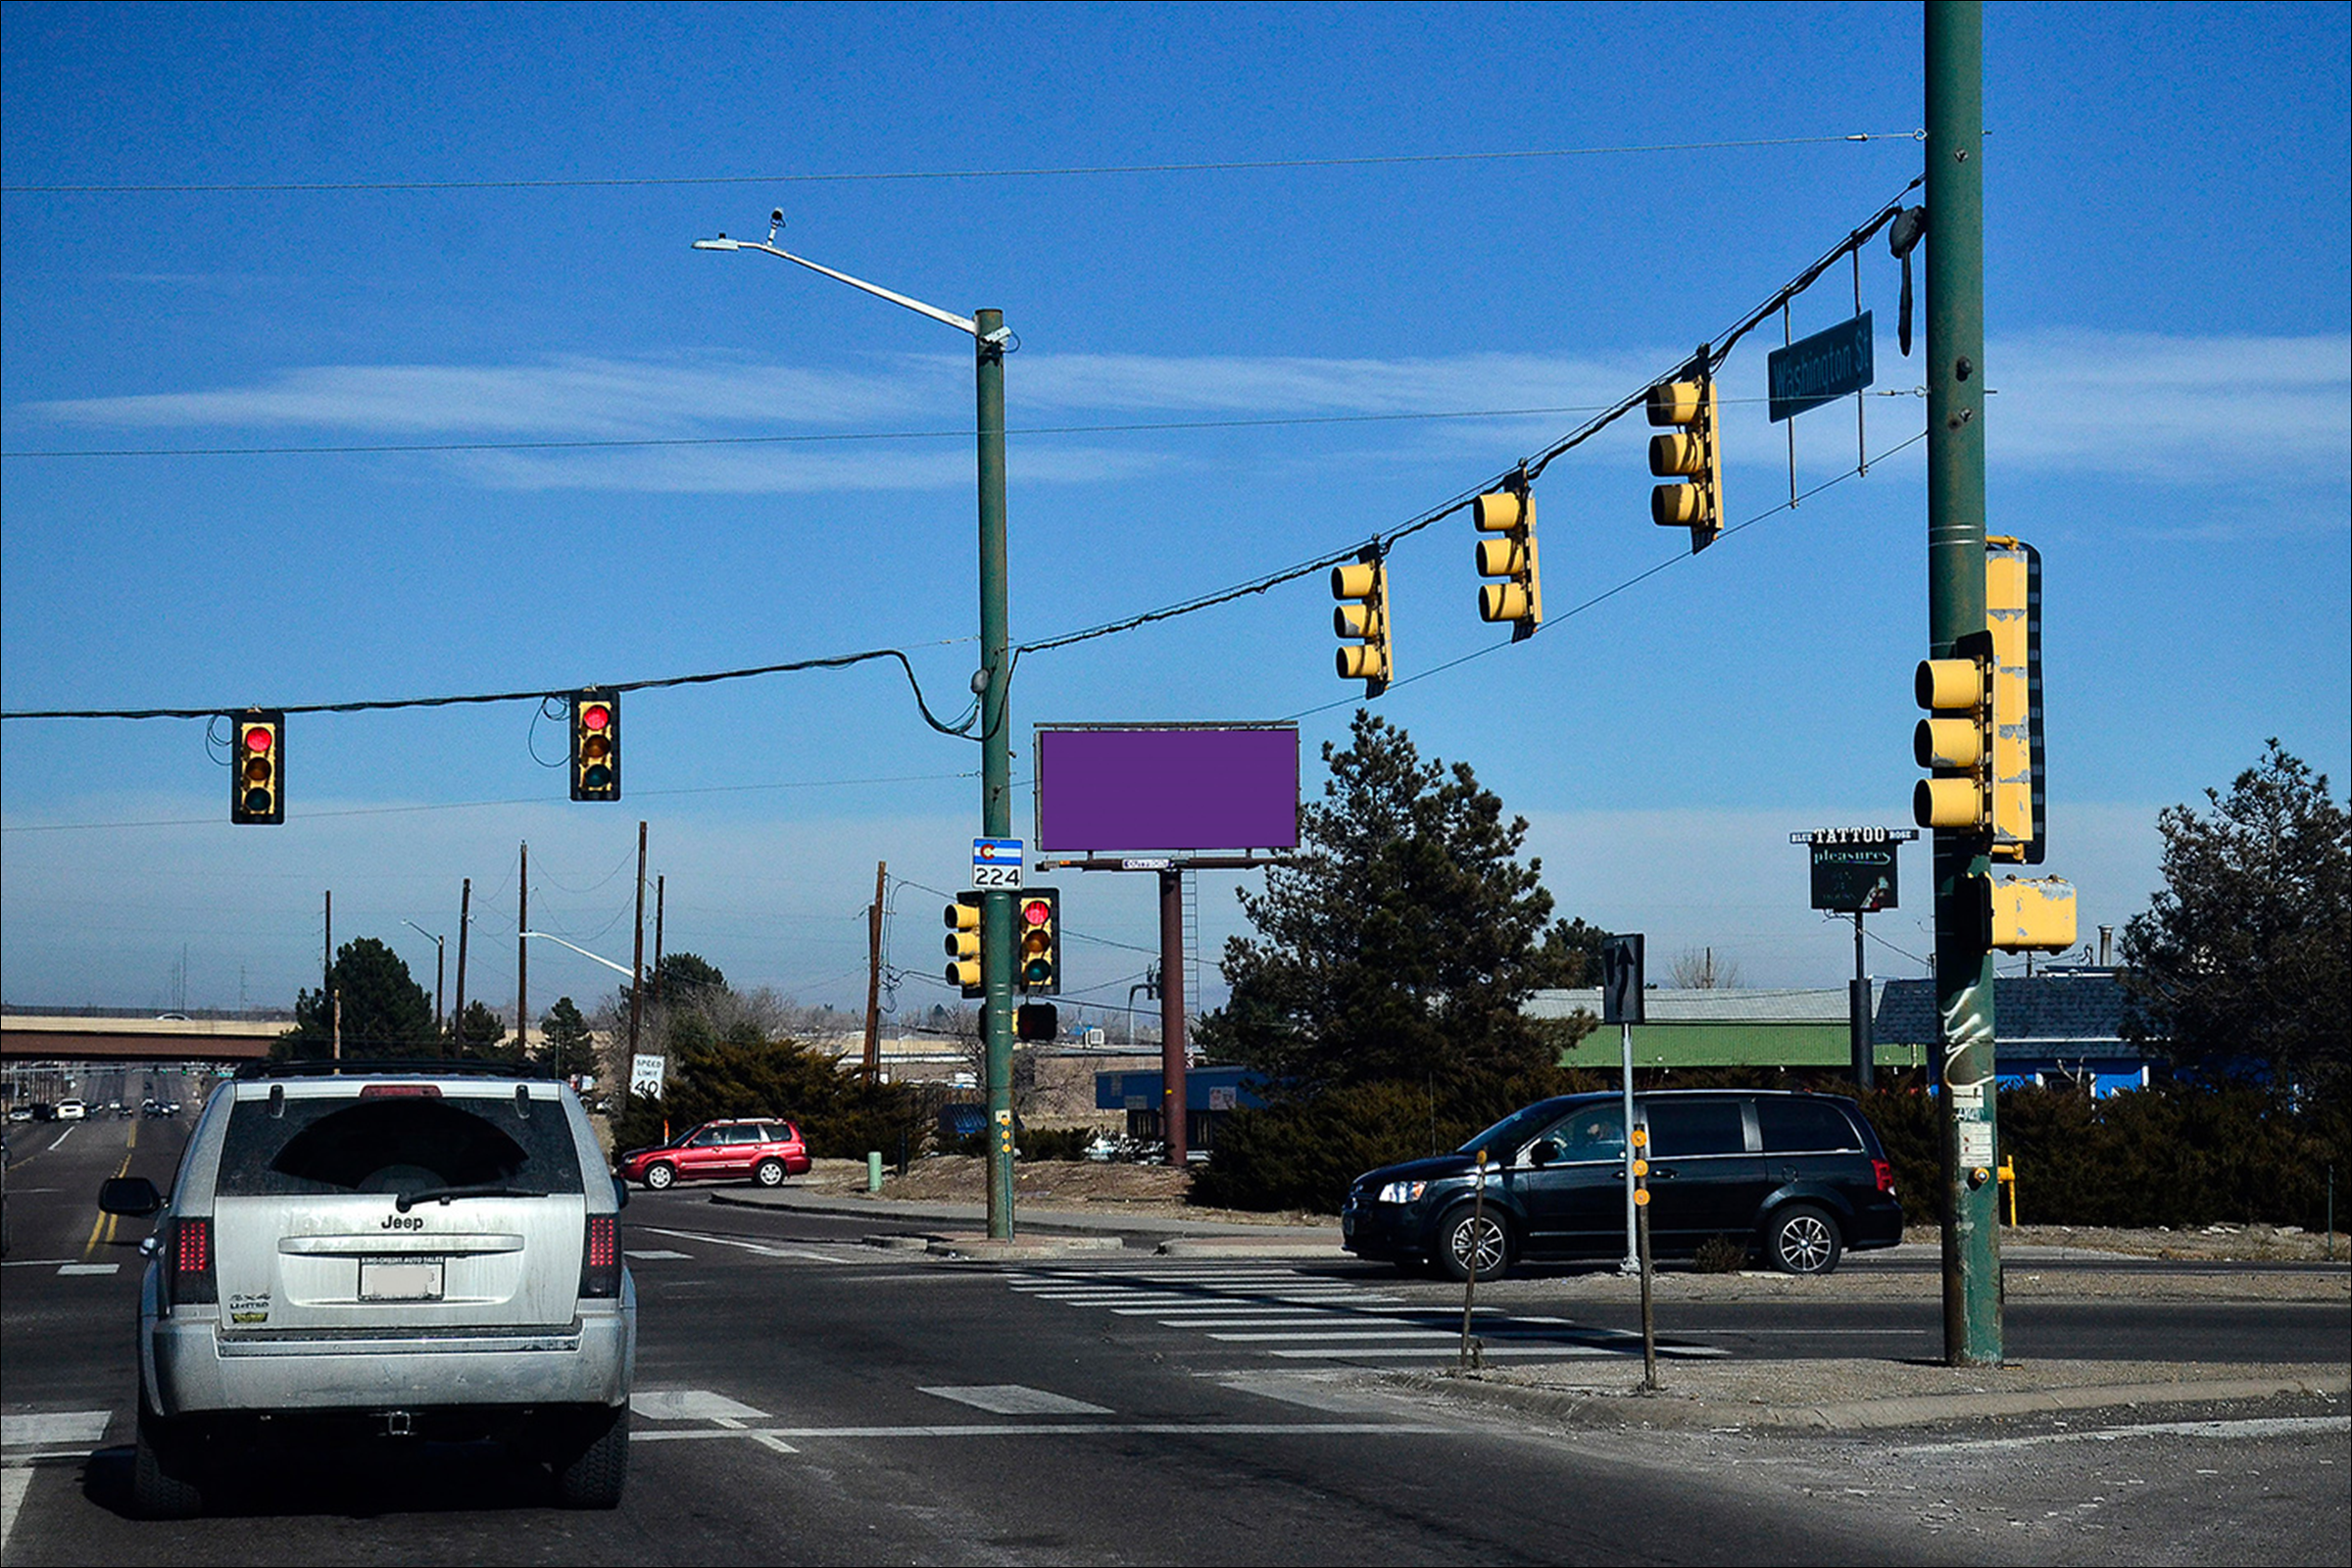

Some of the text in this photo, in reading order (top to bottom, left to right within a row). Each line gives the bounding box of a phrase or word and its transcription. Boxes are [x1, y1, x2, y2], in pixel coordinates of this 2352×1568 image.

[1773, 328, 1869, 403] Washington St
[1814, 826, 1886, 844] TATTOO
[1888, 830, 1912, 840] ROSE
[1814, 849, 1891, 865] pleasures
[975, 867, 1020, 886] 224
[636, 1059, 662, 1068] SPEED
[634, 1080, 660, 1098] 40
[381, 1214, 424, 1231] Jeep
